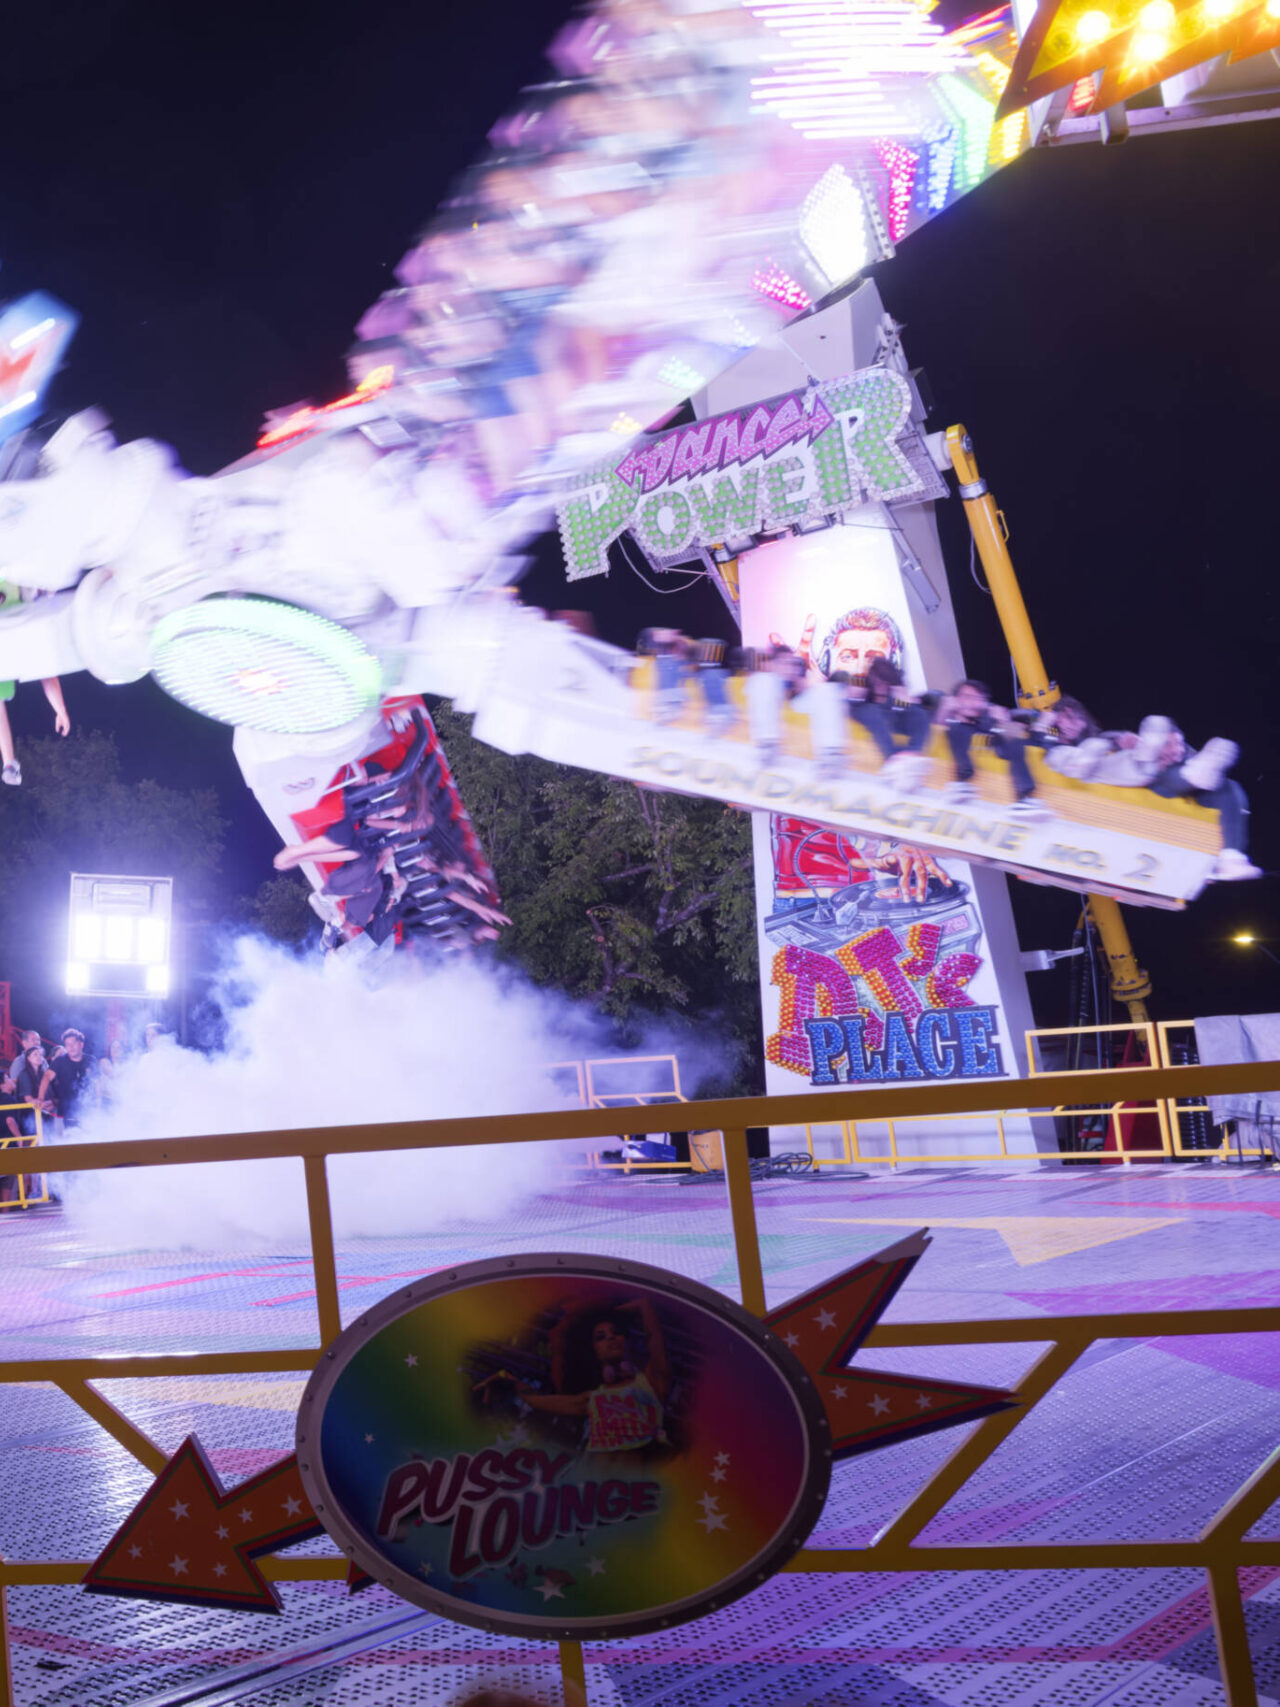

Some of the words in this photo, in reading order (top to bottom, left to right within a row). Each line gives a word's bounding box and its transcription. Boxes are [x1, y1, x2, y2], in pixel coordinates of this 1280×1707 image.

[1123, 853, 1160, 881] 2
[805, 1009, 1001, 1083] PLACE
[377, 1448, 572, 1537] PUSSY
[449, 1478, 660, 1579] LOUNGE
